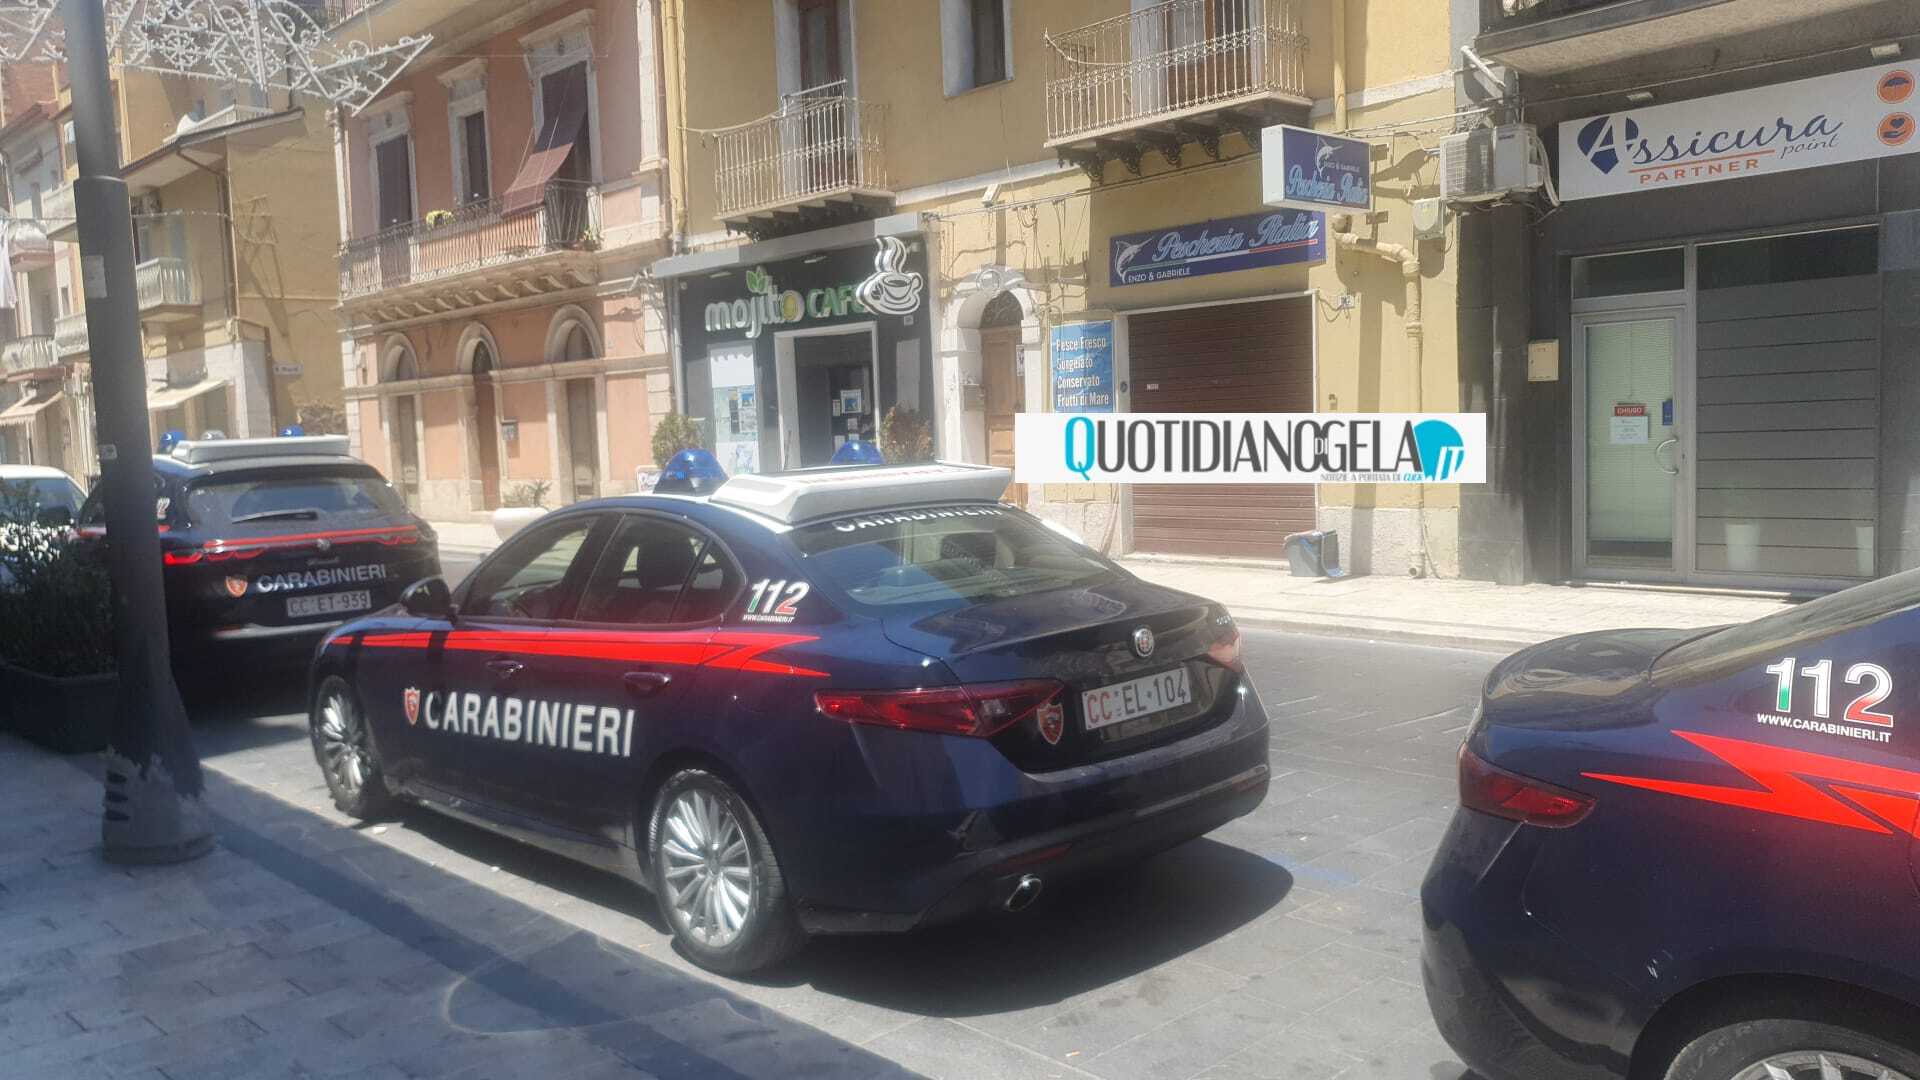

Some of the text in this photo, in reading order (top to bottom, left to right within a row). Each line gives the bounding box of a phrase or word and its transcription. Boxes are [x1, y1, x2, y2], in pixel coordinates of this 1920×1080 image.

[1577, 114, 1843, 175] Assicura
[1780, 134, 1839, 159] point
[1639, 158, 1760, 184] PARTNER
[1152, 213, 1320, 262] Pescheria Italia
[1128, 267, 1191, 283] ENZO & GABRIELE
[704, 275, 805, 339] mojito
[1056, 336, 1107, 353] Pesce Fresco
[1057, 376, 1100, 389] Conservato
[1057, 394, 1078, 407] Frutti
[1089, 391, 1109, 405] Mare
[257, 564, 387, 592] CARABINIERI
[748, 579, 810, 615] 112
[1087, 692, 1112, 723] CC
[1766, 657, 1894, 728] 112
[424, 691, 635, 757] CARABINIERI
[1757, 713, 1892, 743] WWW.CARABINIERI.IT
